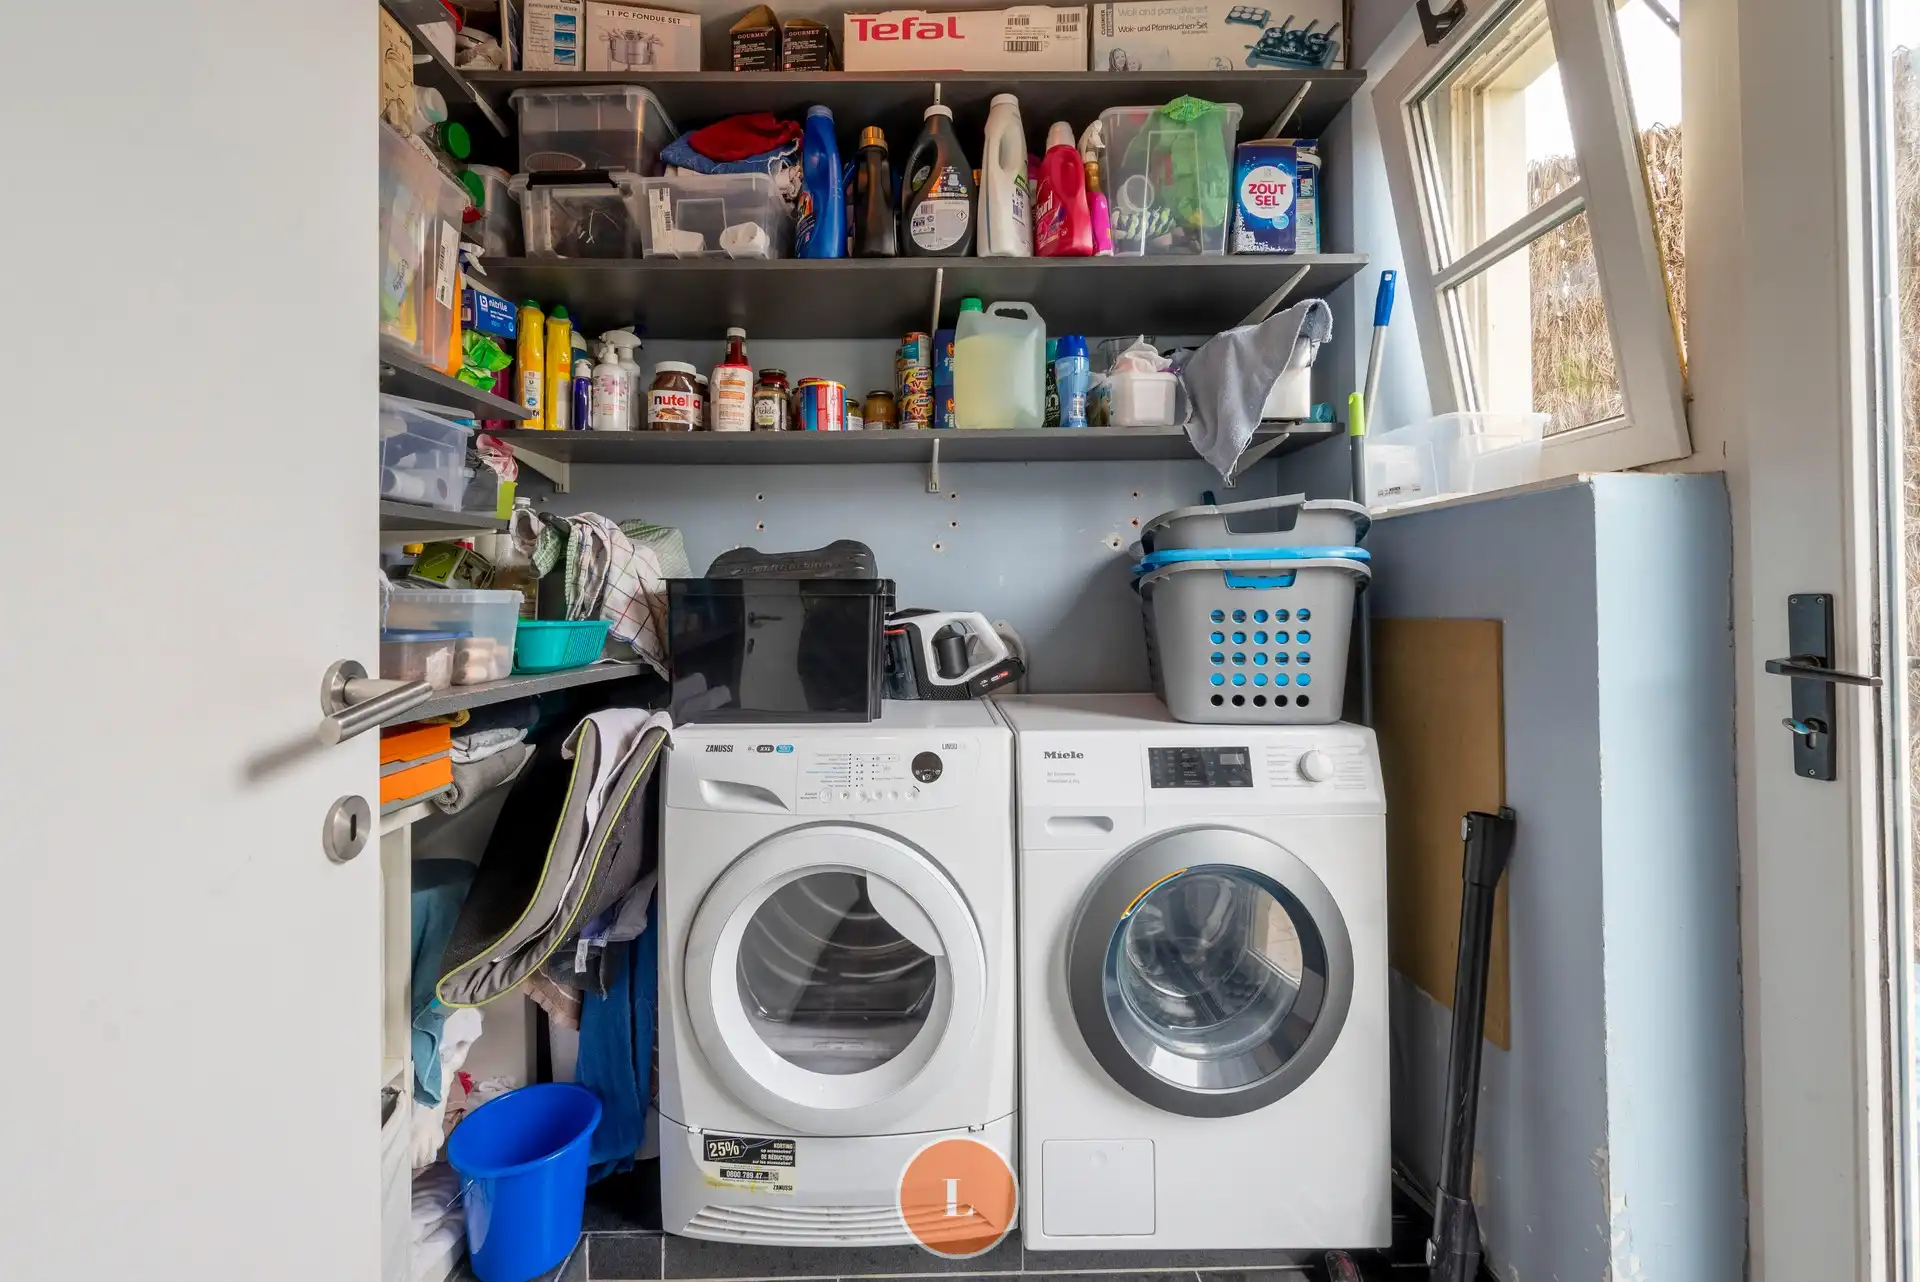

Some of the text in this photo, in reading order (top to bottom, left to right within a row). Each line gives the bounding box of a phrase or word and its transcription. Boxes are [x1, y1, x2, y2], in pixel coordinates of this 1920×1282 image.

[632, 12, 665, 23] FONDUE
[850, 16, 965, 42] Tefal
[1248, 183, 1287, 195] ZOUT
[1255, 195, 1280, 206] SEL
[654, 393, 701, 409] nutela
[705, 745, 734, 753] ZANUSSI
[1044, 751, 1084, 759] Miele
[709, 1140, 740, 1158] 25%
